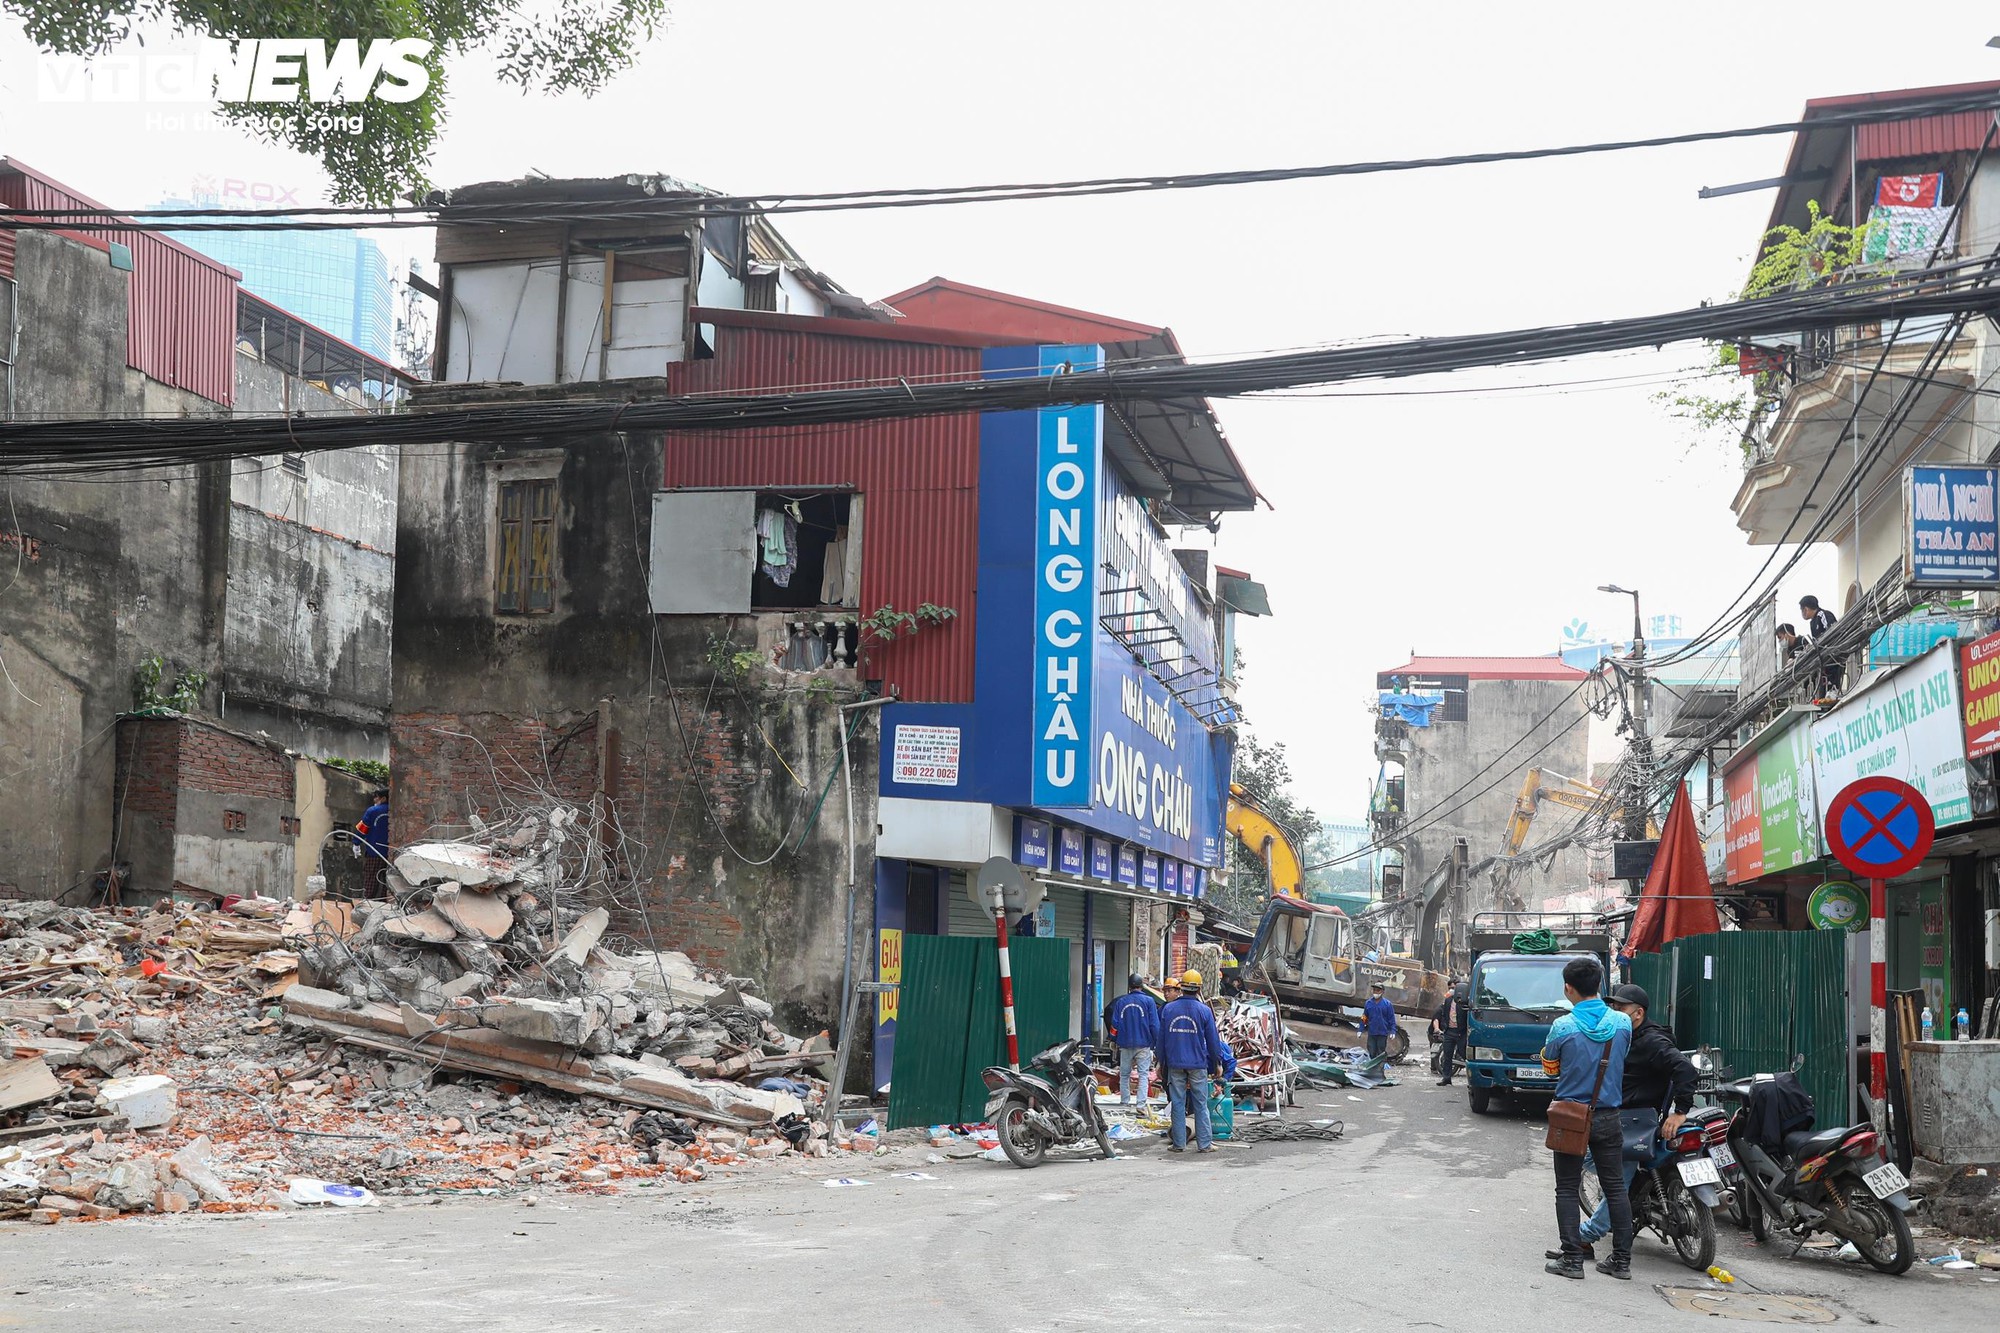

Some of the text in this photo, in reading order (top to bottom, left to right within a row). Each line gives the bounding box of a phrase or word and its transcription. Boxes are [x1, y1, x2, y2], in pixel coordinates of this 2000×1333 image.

[222, 178, 300, 206] ROX
[1914, 470, 1995, 522] NHÀ NGHỈ
[1916, 526, 1995, 551] THÁI AN
[1043, 416, 1085, 788] LONG CHÂU
[1968, 656, 2000, 692] UNIO
[1121, 674, 1176, 751] NHÀ THUỐC
[1824, 669, 1952, 764] NHÀ THUỐC MINH ANH
[1966, 691, 2000, 728] GAMI
[902, 766, 957, 779] 090 222 0025
[1884, 746, 1897, 769] GPP
[1096, 731, 1193, 841] ONG CHÂU
[1922, 893, 1944, 936] CHÁ
[881, 932, 900, 969] GIÁ
[1715, 1155, 1735, 1168] 263.
[1874, 1175, 1906, 1197] 114.42
